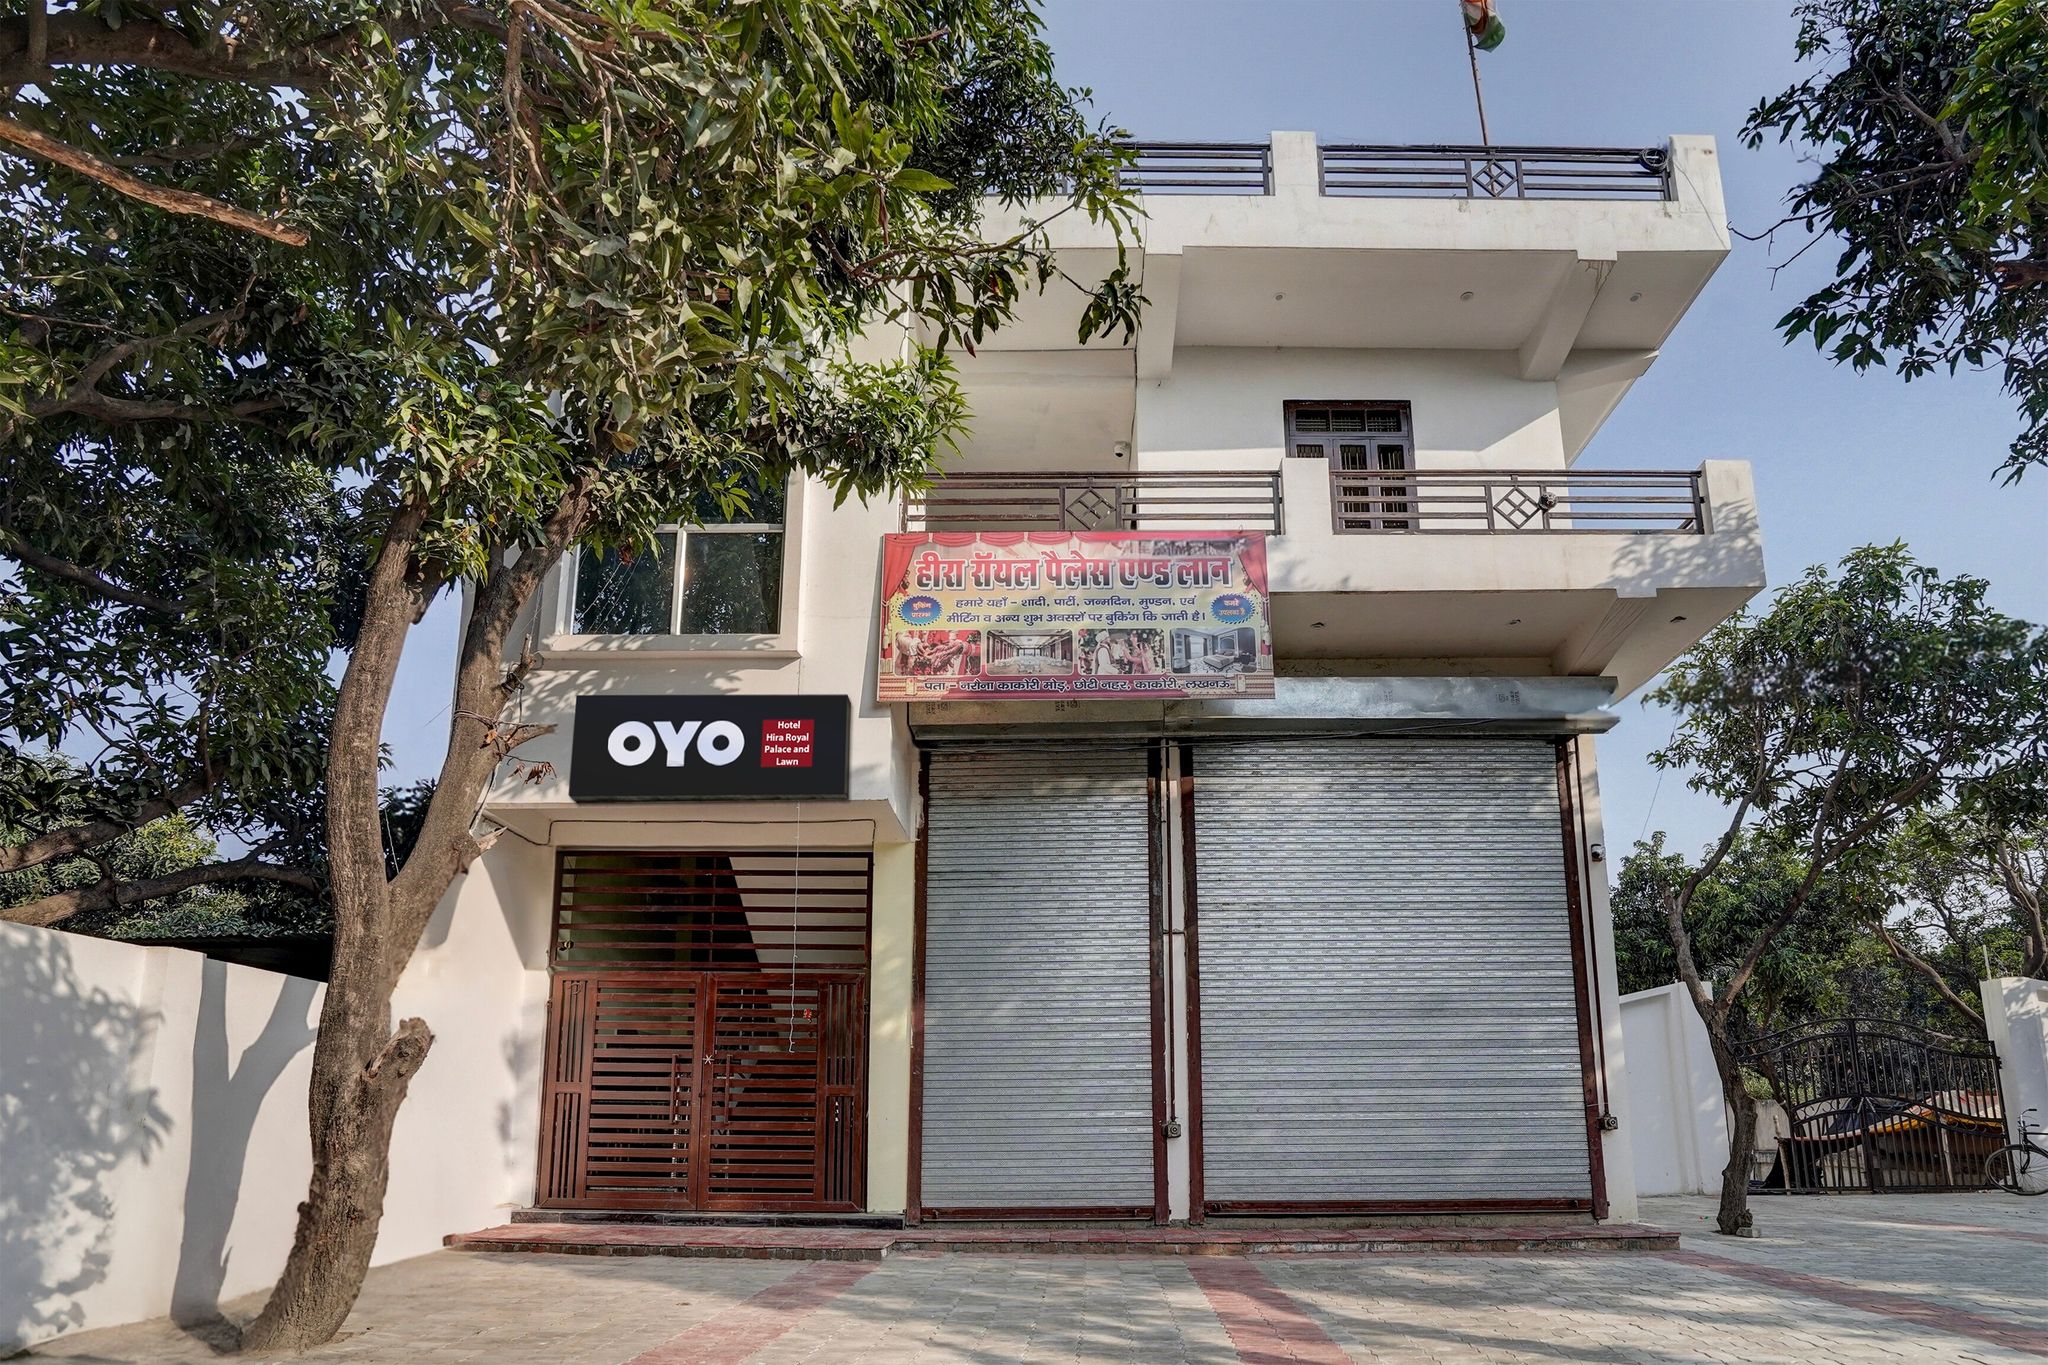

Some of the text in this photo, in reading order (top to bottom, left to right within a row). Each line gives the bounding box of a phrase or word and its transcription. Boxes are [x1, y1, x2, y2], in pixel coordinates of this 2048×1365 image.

[915, 550, 1233, 590] हीरा रॉयल पैलेस एण्ड लान
[955, 597, 983, 608] हमारे
[986, 596, 1009, 608] यहाँ
[1180, 595, 1198, 606] एवं
[946, 611, 980, 623] मीटिंग
[984, 614, 992, 623] व
[995, 614, 1020, 623] अन्य
[1023, 614, 1043, 626] शुभ
[1046, 610, 1086, 622] अवसरों
[1088, 613, 1103, 622] पर
[1105, 610, 1139, 625] बुकिंग
[1143, 610, 1157, 622] कि
[1161, 610, 1188, 621] जाती
[924, 681, 945, 691] पता
[997, 678, 1040, 690] काकोरी
[1073, 677, 1099, 690] छोटी
[1184, 679, 1230, 689] लखनऊ
[777, 720, 801, 730] Hotel
[607, 720, 745, 767] OYO
[766, 732, 809, 744] Hira Royal
[764, 745, 810, 754] Palace and
[776, 757, 799, 766] Lawn
